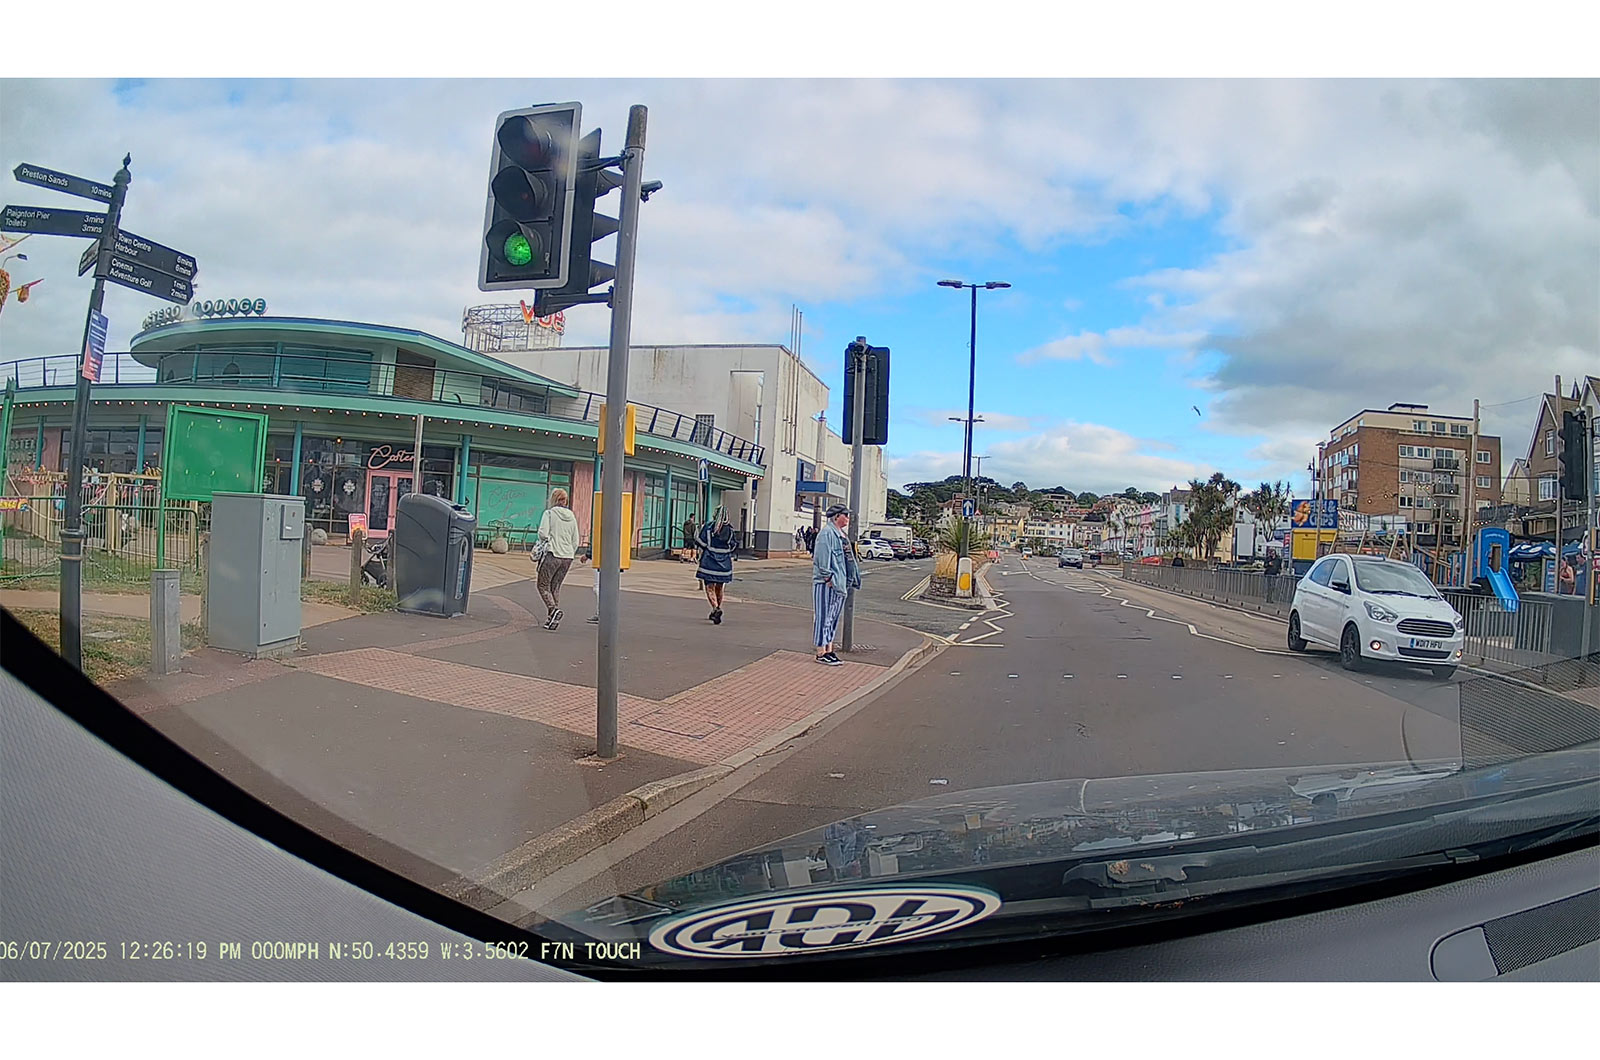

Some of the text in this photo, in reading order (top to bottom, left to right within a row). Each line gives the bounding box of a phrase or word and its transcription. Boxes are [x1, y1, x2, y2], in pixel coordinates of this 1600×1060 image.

[22, 168, 68, 187] Preston Sands
[6, 209, 35, 218] Paignton
[5, 219, 27, 227] Toilets
[115, 242, 138, 256] Harbour
[118, 232, 152, 252] Town Centre
[112, 258, 133, 272] Cinema
[109, 268, 153, 288] Adventure Golf
[193, 299, 264, 316] LOUNGE
[1328, 500, 1336, 512] &
